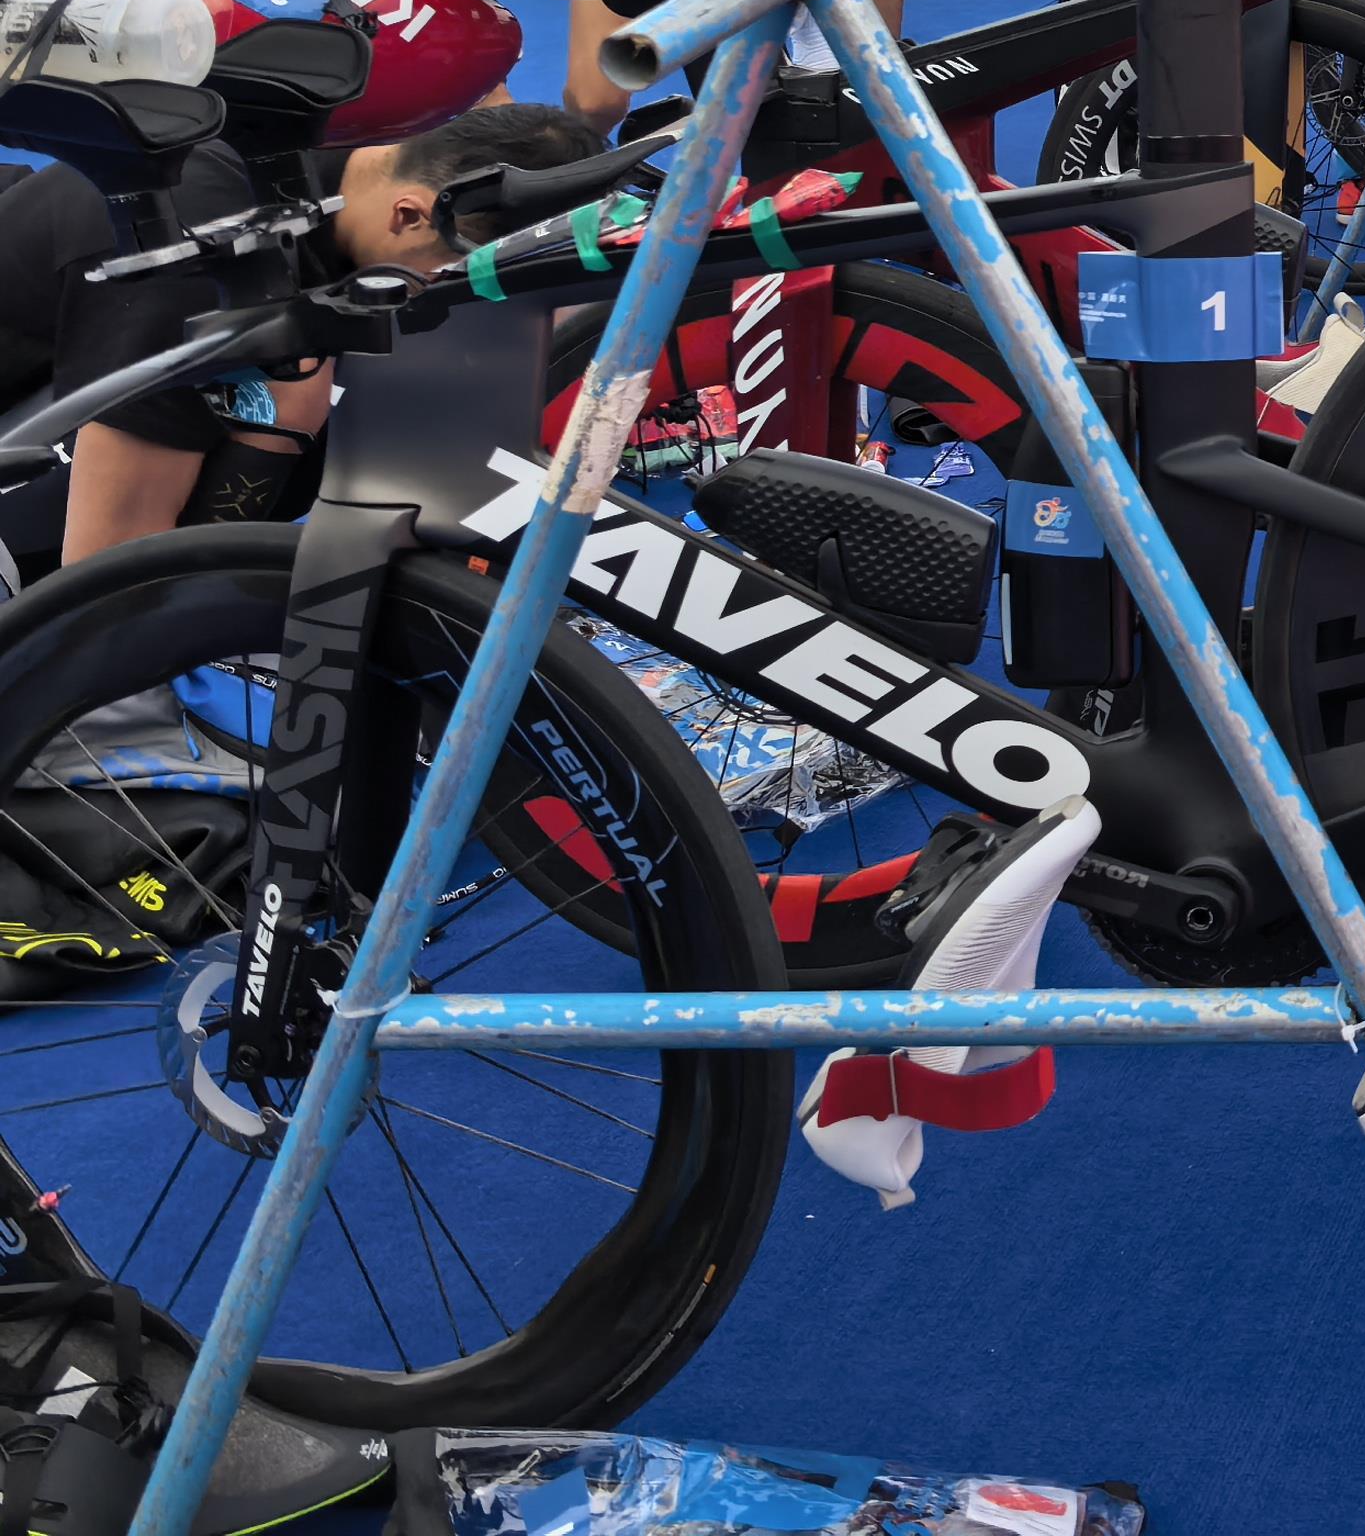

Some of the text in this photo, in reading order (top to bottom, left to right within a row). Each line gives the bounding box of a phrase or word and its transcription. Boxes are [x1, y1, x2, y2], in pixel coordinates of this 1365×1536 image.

[841, 56, 981, 105] CYON
[1098, 58, 1139, 110] DT
[1058, 105, 1104, 184] SWIS
[1200, 290, 1227, 332] 1
[458, 446, 1092, 812] TAVELO
[530, 717, 666, 909] PERTUAL
[242, 881, 283, 1019] TAVELO
